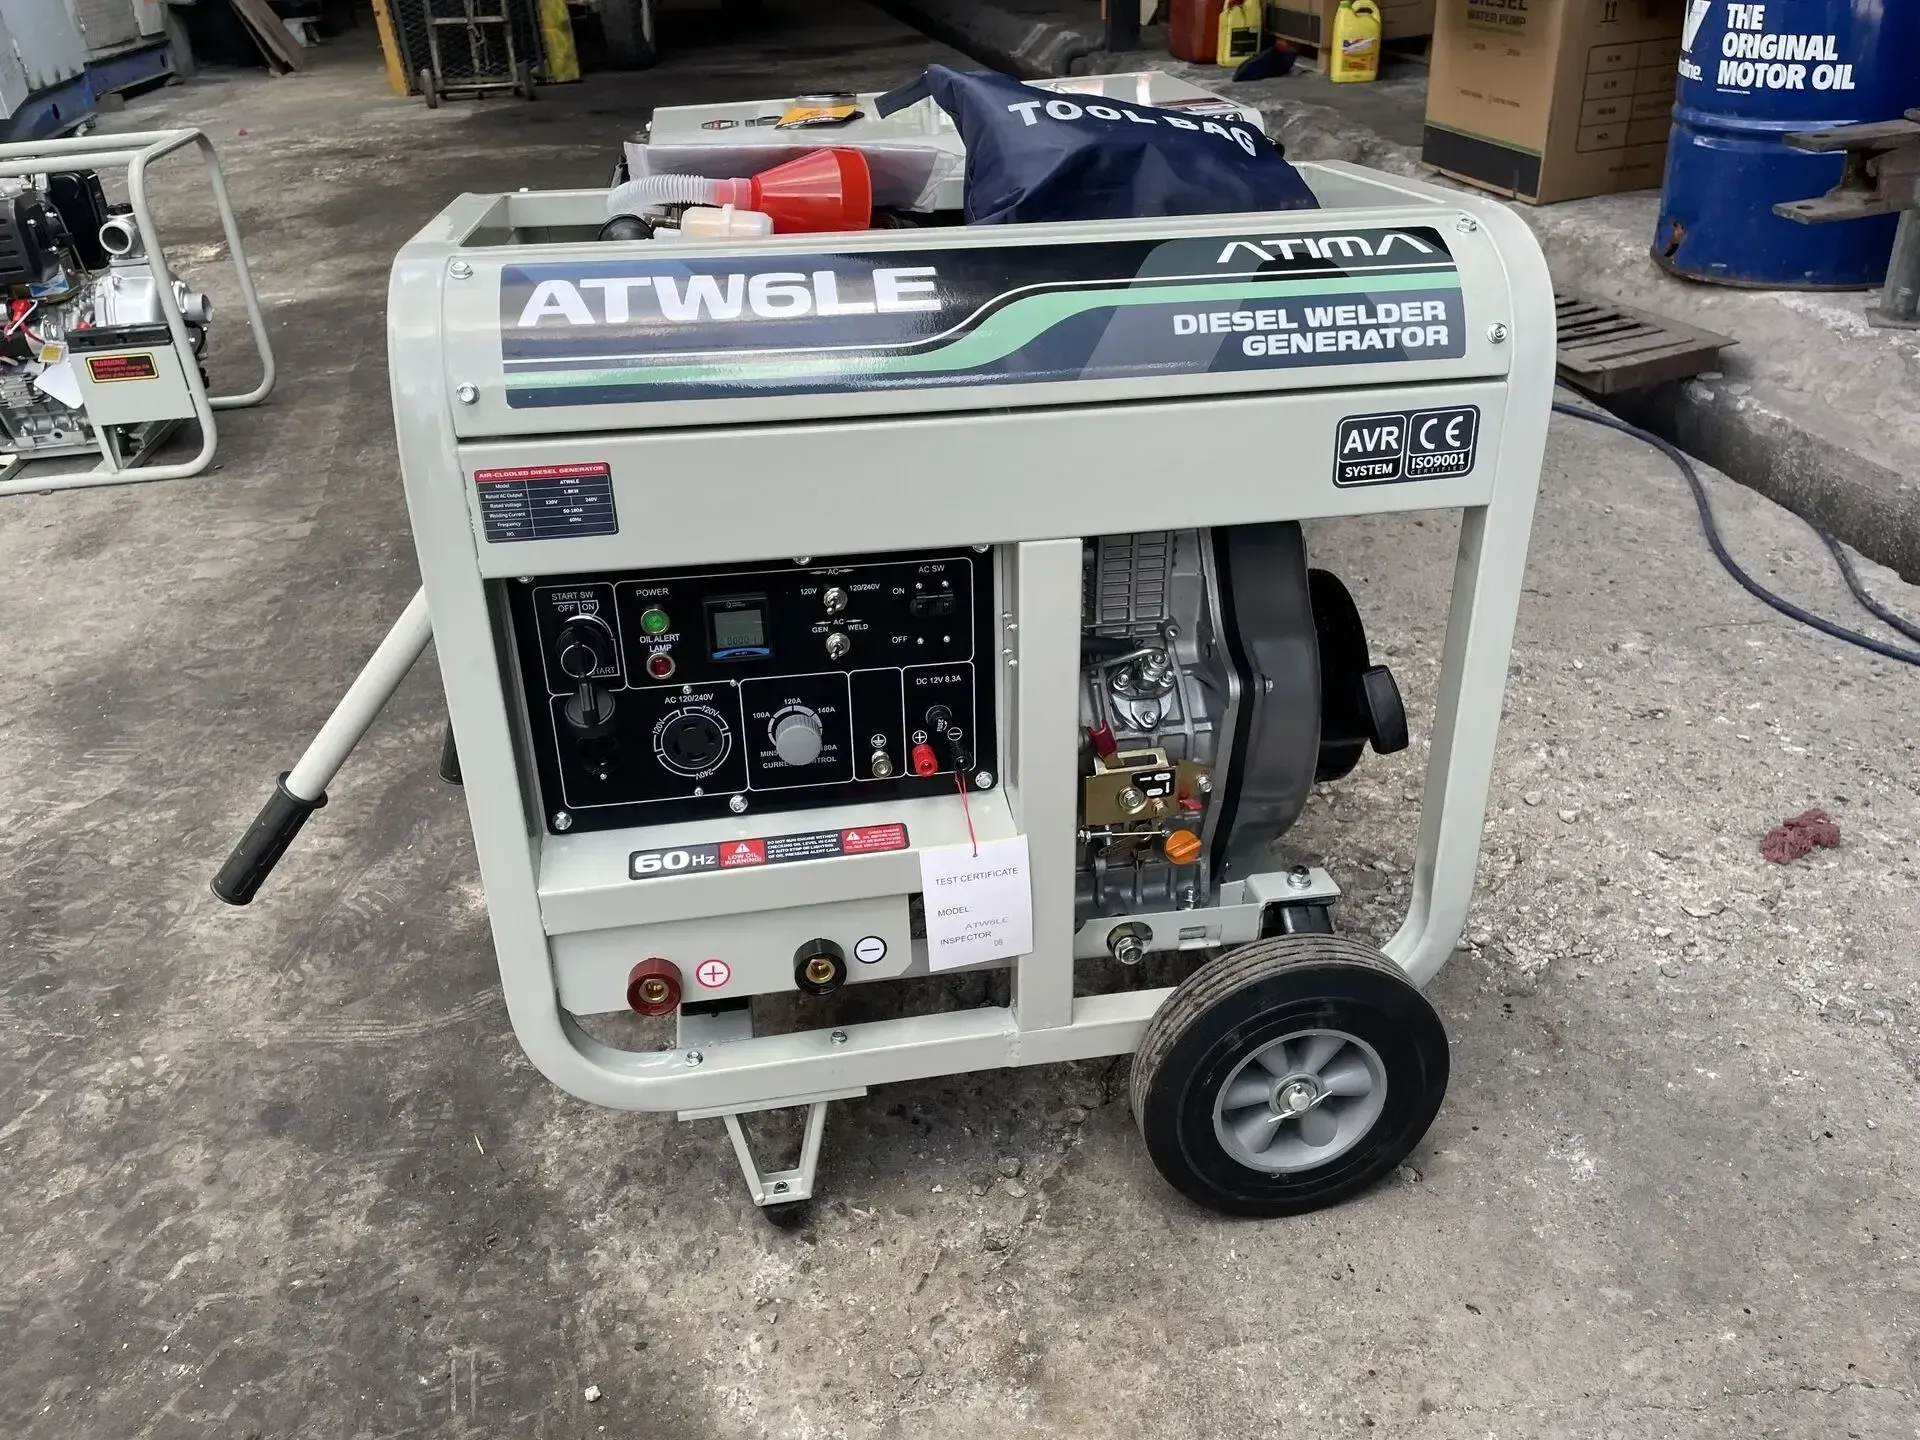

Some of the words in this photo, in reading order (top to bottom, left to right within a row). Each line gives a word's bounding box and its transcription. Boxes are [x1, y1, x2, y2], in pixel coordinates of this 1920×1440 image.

[1727, 3, 1765, 30] THE
[1721, 31, 1839, 61] ORIGINAL
[1717, 60, 1807, 90] MOTOR
[1811, 64, 1856, 91] OIL
[1007, 100, 1158, 127] TOOL
[1161, 115, 1257, 157] BAG
[1216, 234, 1434, 264] ATIMA
[517, 266, 943, 328] ATW6LE
[1173, 309, 1299, 335] DIESEL
[1303, 300, 1447, 328] WELDER
[1241, 324, 1449, 357] GENERATOR
[1343, 426, 1399, 453] AVR
[1411, 453, 1465, 469] ISO9001
[479, 470, 529, 478] AIR-CLOOLED
[1345, 463, 1393, 477] SYSTEM
[1410, 465, 1464, 475] CERTIFIED
[918, 565, 930, 573] AC
[931, 564, 945, 572] SW
[636, 588, 669, 597] POWER
[800, 587, 818, 595] 120V
[849, 583, 880, 591] 120/240V
[892, 587, 905, 595] ON
[551, 592, 578, 601] START
[579, 591, 594, 599] SW
[557, 604, 575, 613] OFF
[581, 603, 595, 611] ON
[812, 626, 829, 634] GEN
[847, 623, 869, 631] WELD
[639, 635, 652, 644] OIL
[652, 633, 681, 643] ALERT
[891, 636, 908, 644] OFF
[649, 644, 672, 653] LAMP
[916, 677, 928, 685] DC
[930, 676, 943, 684] 12V
[945, 675, 961, 683] 8.3A
[664, 696, 677, 704] AC
[678, 693, 714, 703] 120/240V
[701, 704, 719, 717] 120V
[752, 711, 771, 719] 100A
[817, 706, 836, 714] 140A
[652, 718, 666, 735] 120V
[762, 760, 791, 769] CURRE
[695, 767, 713, 780] 240V
[724, 856, 762, 865] WARNING!
[935, 876, 958, 886] TEST
[960, 867, 1019, 883] CERTIFICATE
[964, 916, 1009, 930] ATW6LE
[940, 930, 992, 946] INSPECTOR
